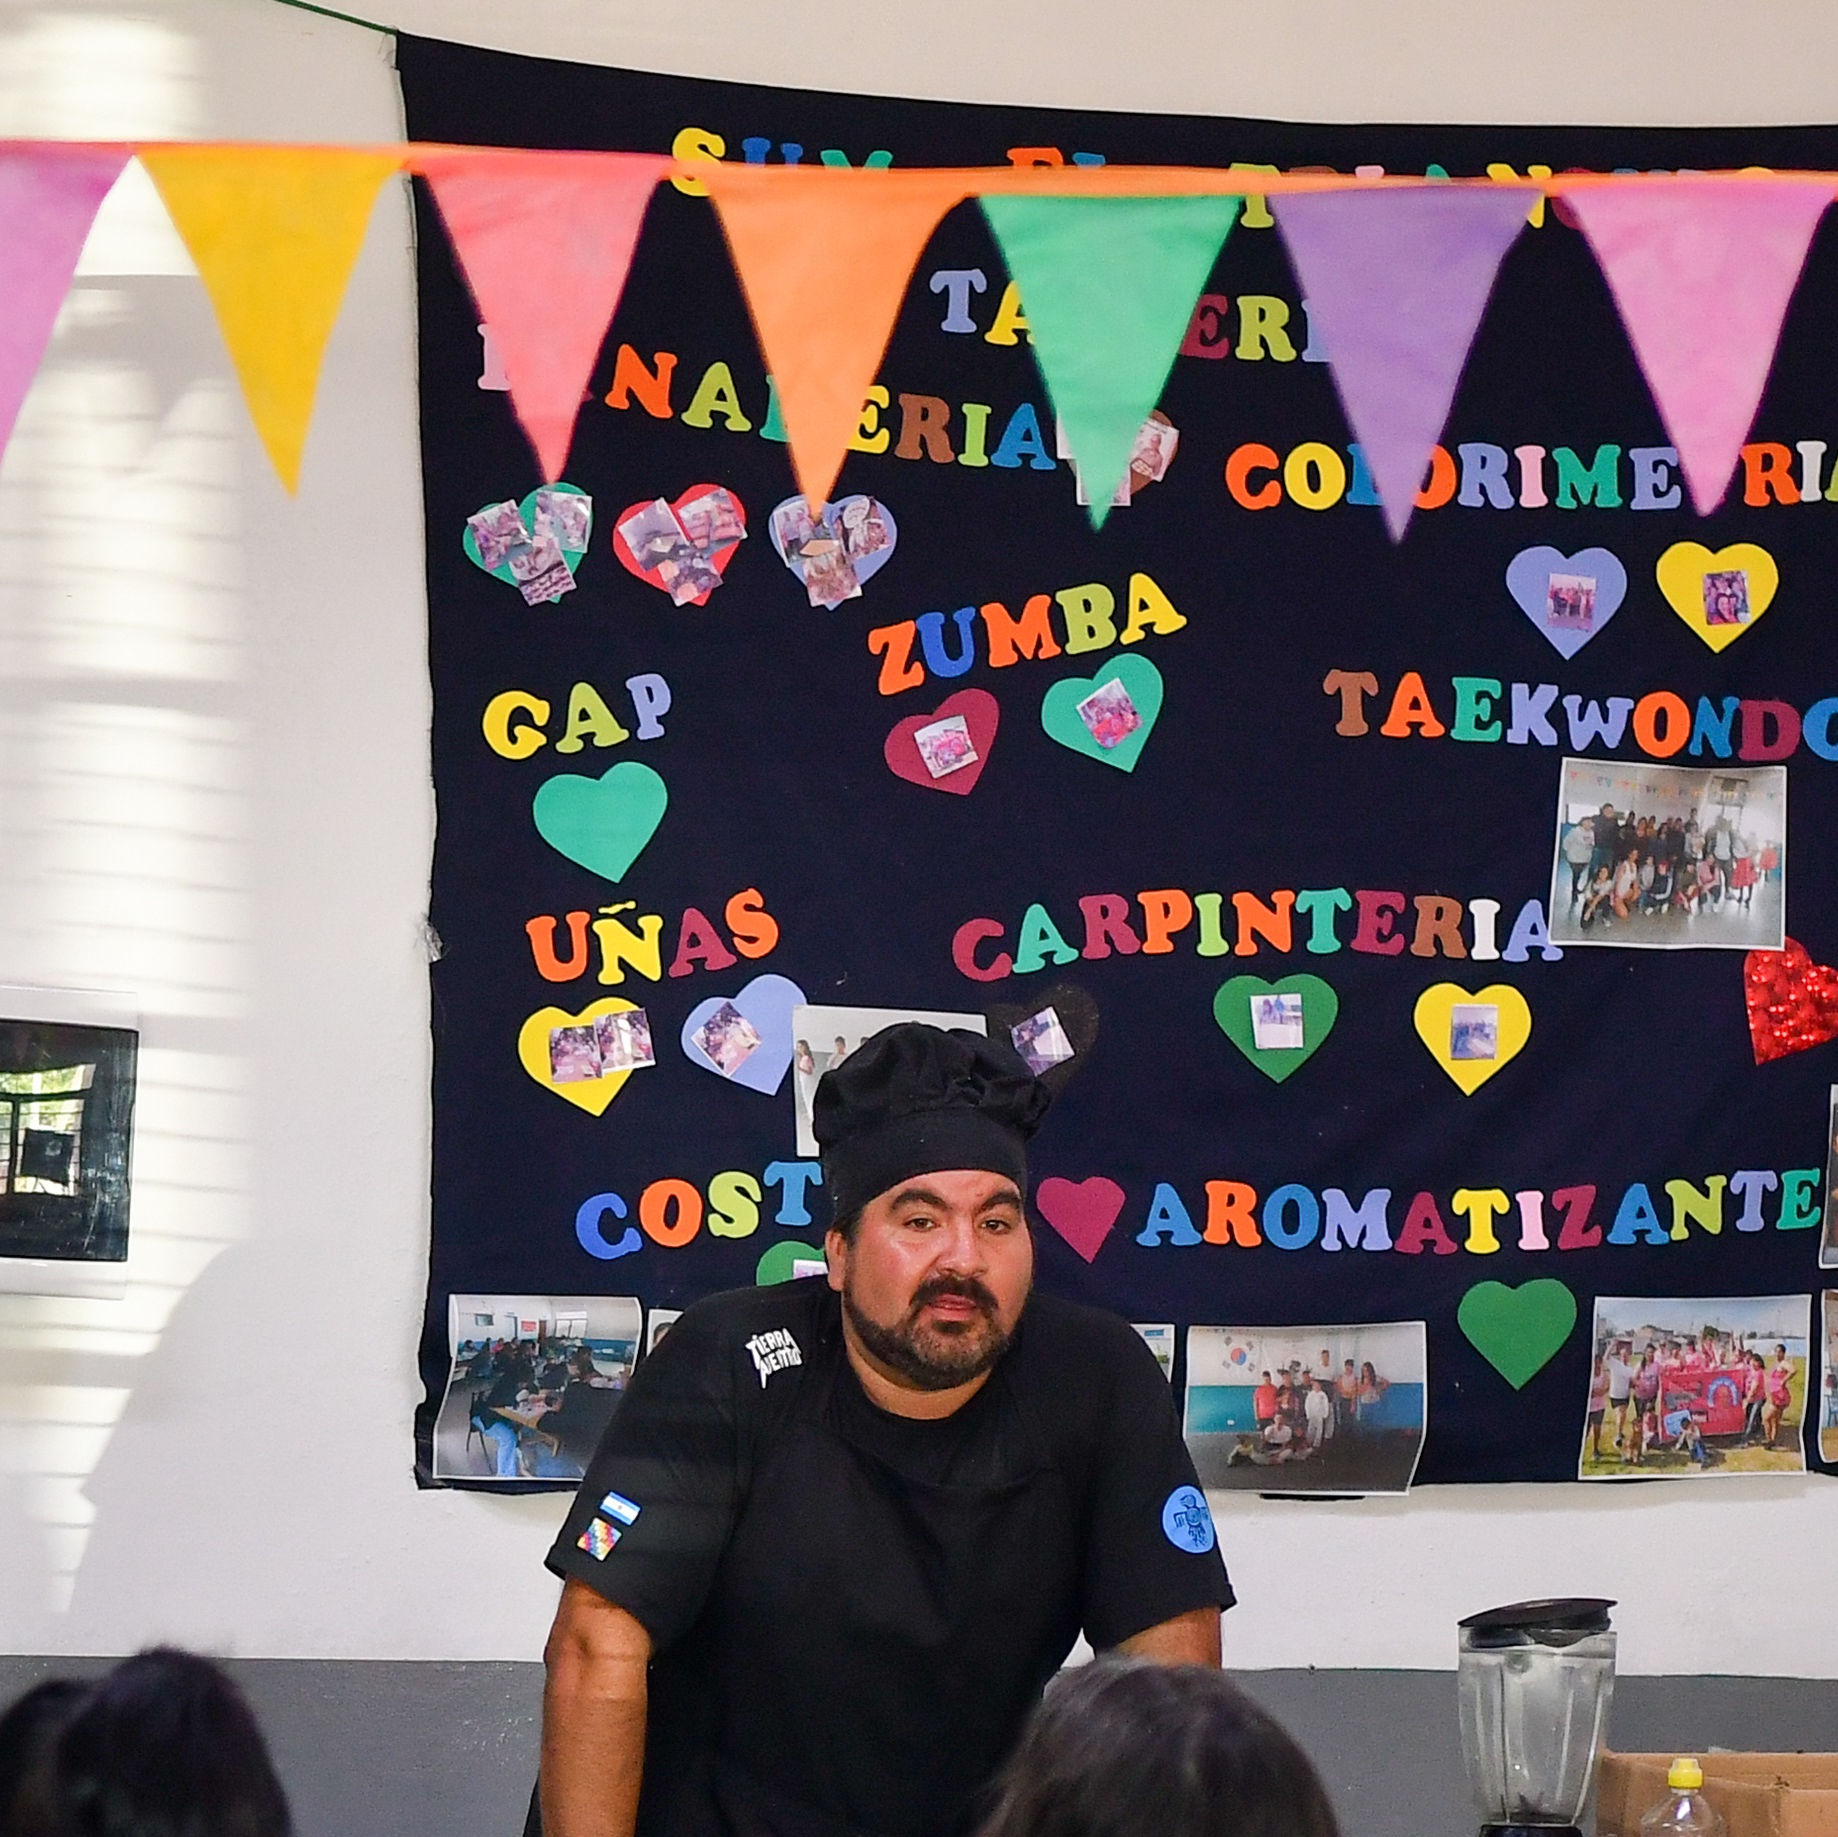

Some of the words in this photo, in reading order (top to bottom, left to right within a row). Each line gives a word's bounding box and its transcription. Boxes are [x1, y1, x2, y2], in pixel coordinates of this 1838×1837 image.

[867, 572, 1188, 697] ZUMBA
[482, 673, 672, 760] GAP
[525, 887, 780, 985] UÑAS
[952, 887, 1563, 981] CARPINTERIA
[575, 1160, 823, 1260] COST
[1136, 1168, 1821, 1255] AROMATIZANTE
